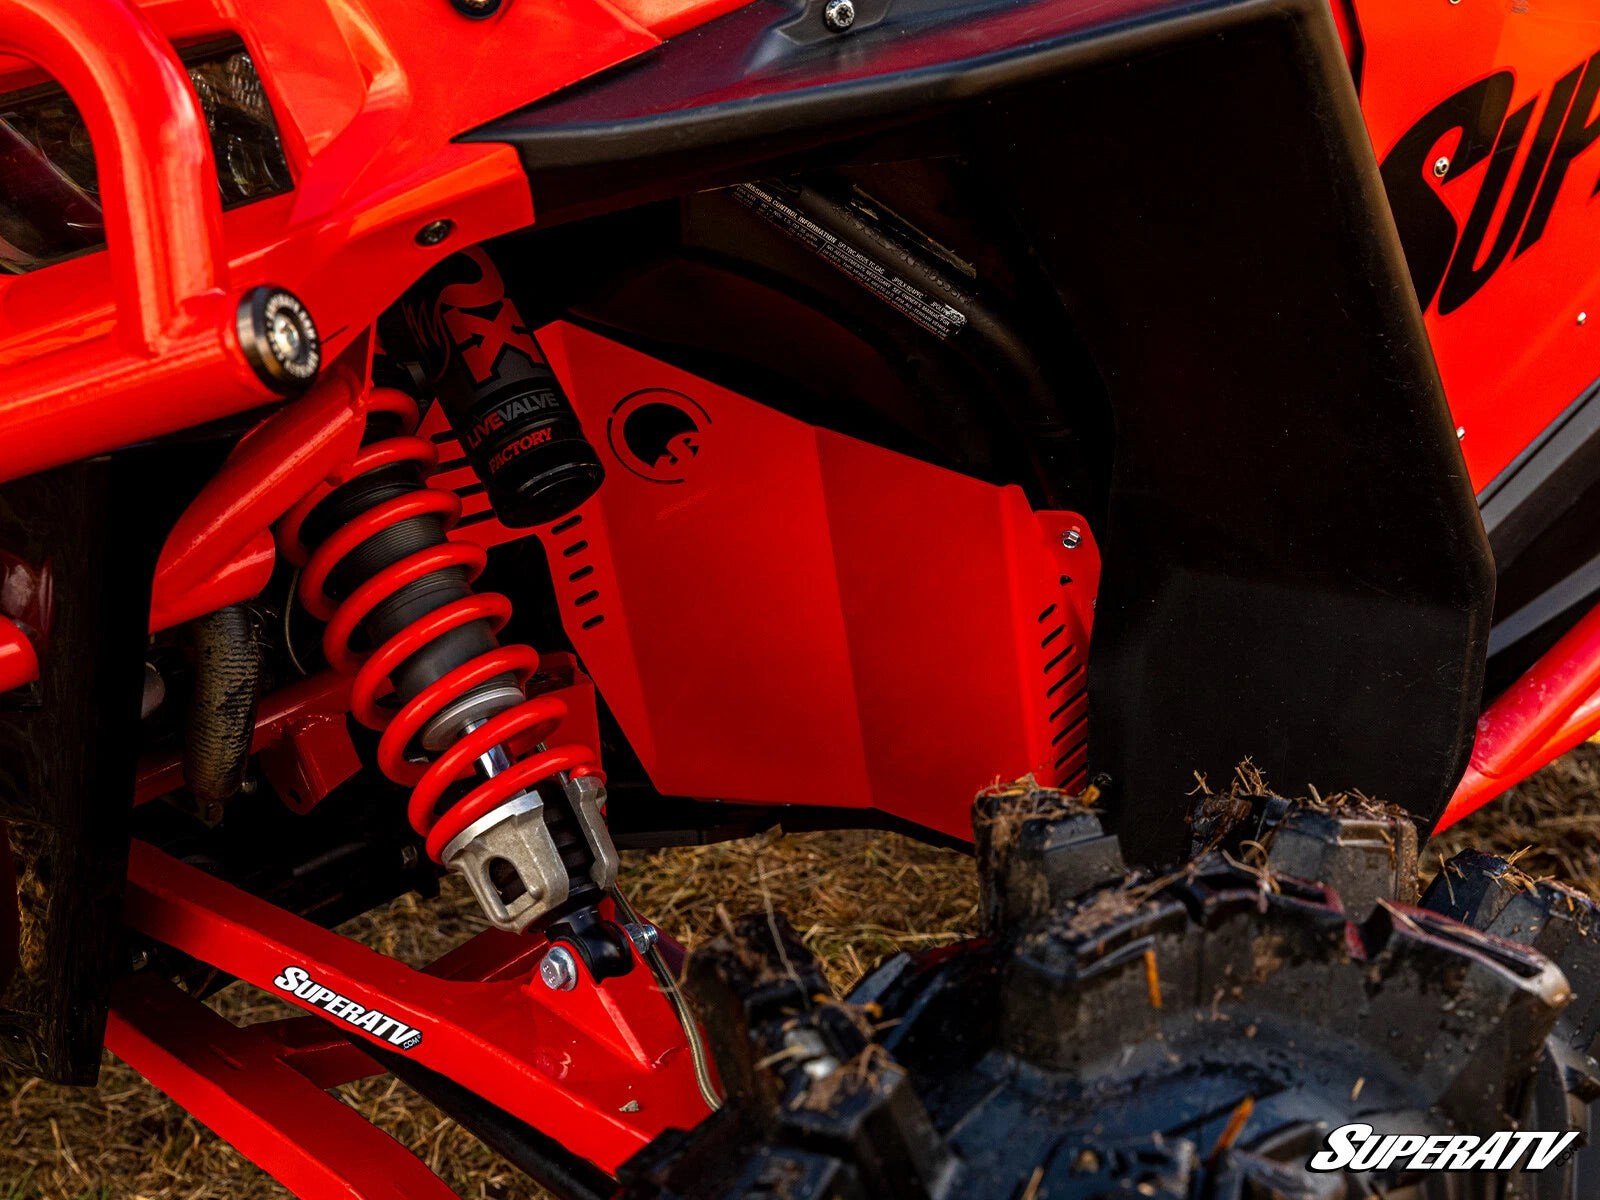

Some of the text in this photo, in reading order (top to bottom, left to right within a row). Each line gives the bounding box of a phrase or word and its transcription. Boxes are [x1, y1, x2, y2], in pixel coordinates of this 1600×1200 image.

[743, 182, 773, 203] MISSIONS
[772, 199, 798, 218] CONTROL
[797, 215, 837, 243] INFORMATION
[1379, 49, 1600, 316] SUP
[488, 427, 552, 475] FACTORY
